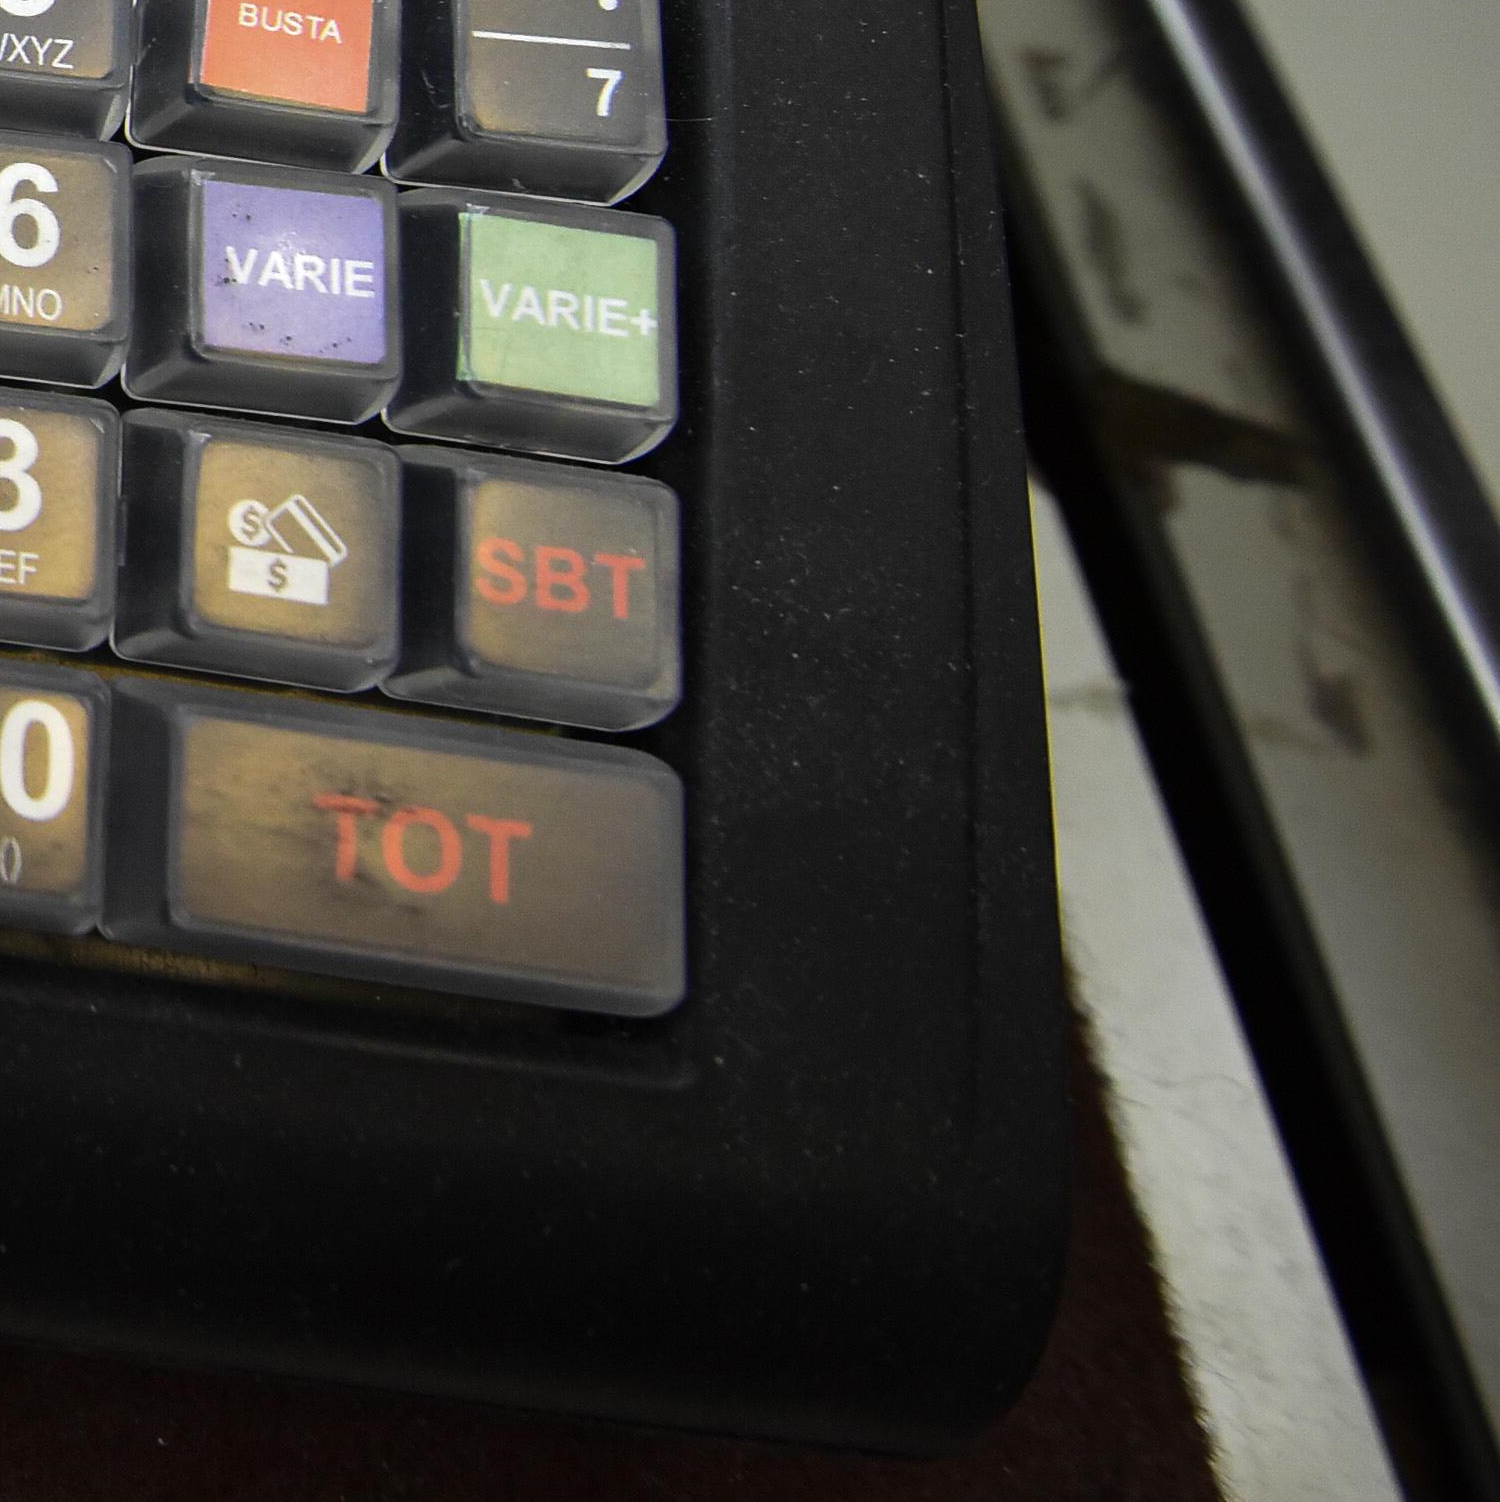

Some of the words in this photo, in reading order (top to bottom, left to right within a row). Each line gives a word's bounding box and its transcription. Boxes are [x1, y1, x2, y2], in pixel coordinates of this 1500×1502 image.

[238, 2, 344, 45] BUSTA
[586, 68, 623, 117] 7
[224, 245, 375, 299] VARIE
[477, 278, 659, 339] VARIE+
[474, 536, 647, 620] SBT
[313, 792, 532, 905] TOT
